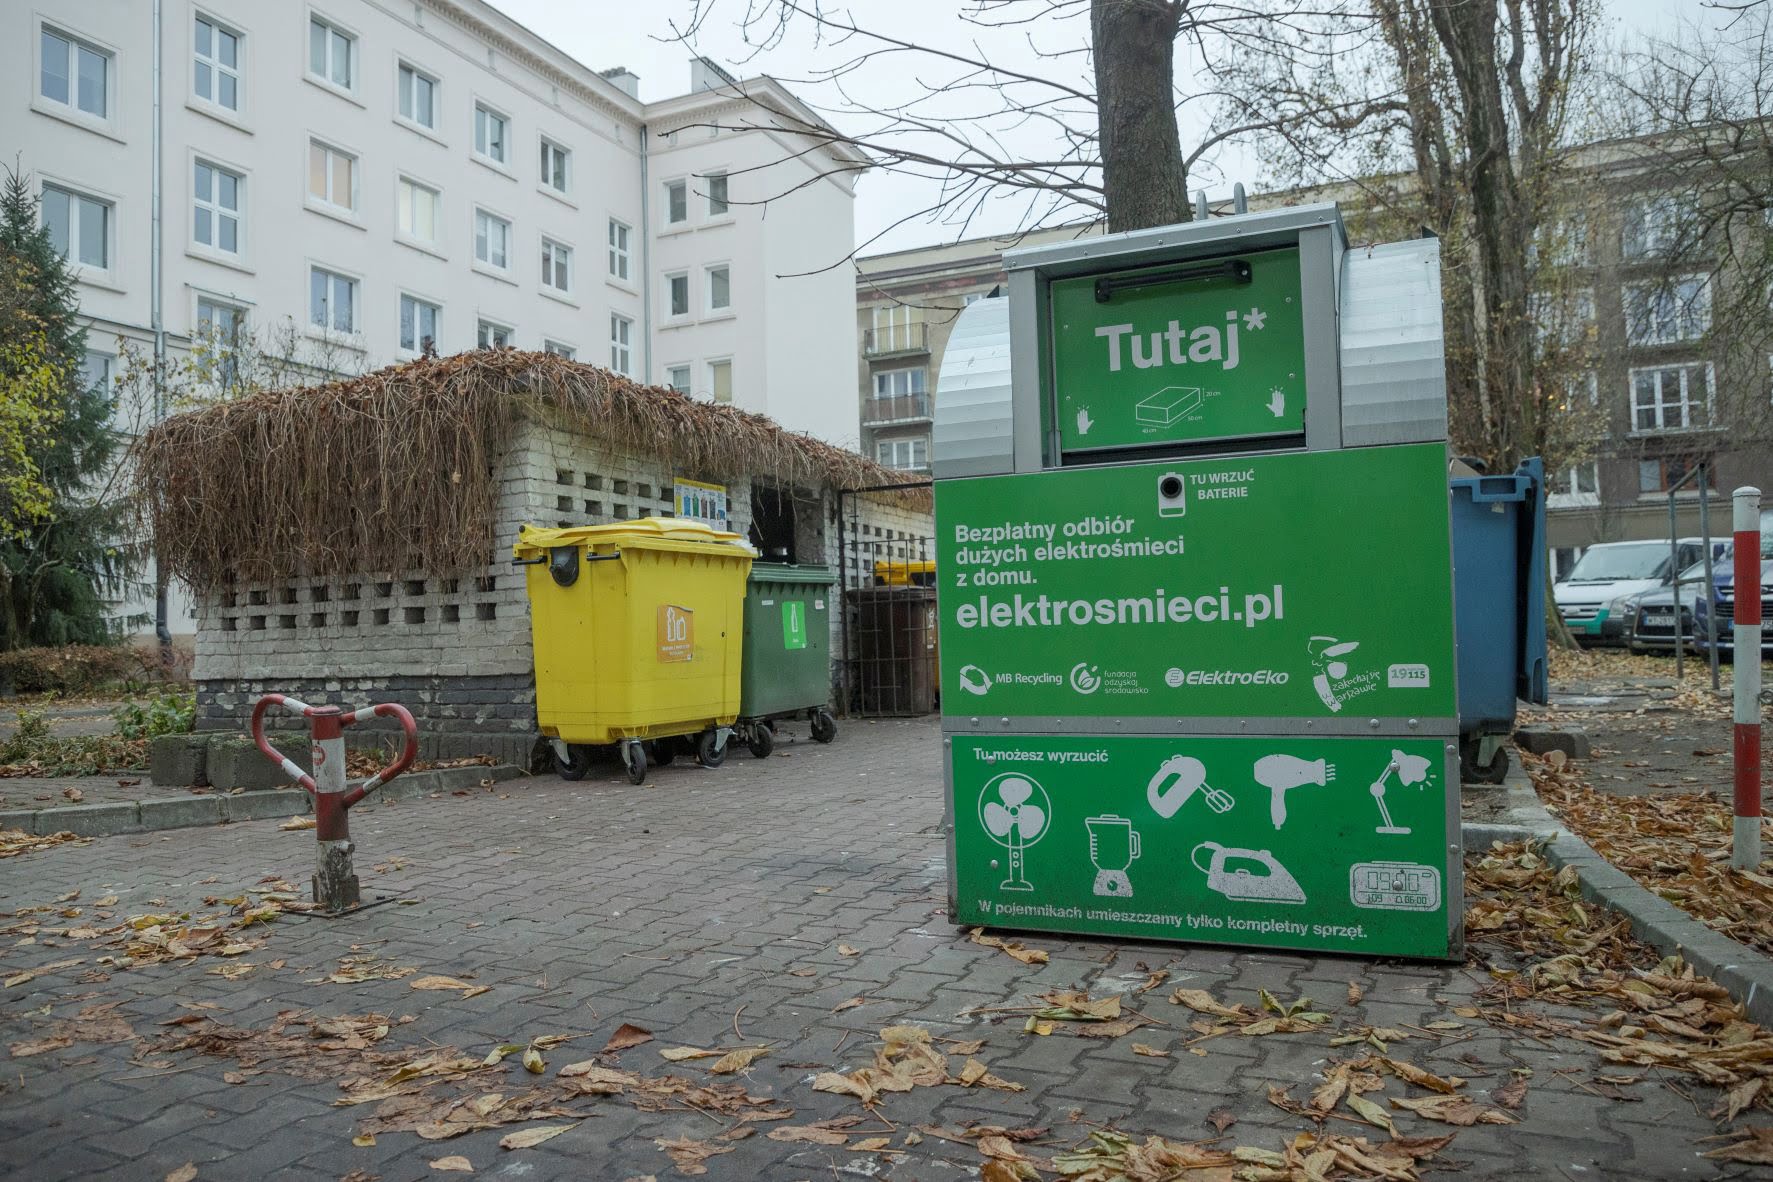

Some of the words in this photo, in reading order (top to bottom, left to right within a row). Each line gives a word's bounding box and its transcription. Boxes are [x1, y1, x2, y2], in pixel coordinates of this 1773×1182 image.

[1190, 474, 1206, 484] TU
[1208, 468, 1254, 483] WRZUĆ
[1198, 487, 1248, 499] BATERIE
[956, 522, 1056, 544] Bezpłatny
[1062, 516, 1134, 536] odbiór
[956, 544, 1027, 567] dużych
[1034, 536, 1184, 560] elektrośmieci
[956, 573, 967, 586] z
[974, 568, 1038, 586] domu.
[956, 584, 1284, 628] elektrosmieci.pl
[996, 673, 1012, 683] MB
[1016, 673, 1062, 686] Recycling
[1186, 670, 1289, 684] ElektroEko
[1332, 671, 1370, 690] zakochaj
[973, 748, 988, 760] Tu
[992, 748, 1044, 761] możesz
[1047, 750, 1108, 764] wyrzucić
[978, 900, 992, 912] W
[995, 903, 1082, 919] pojemnikach
[1087, 908, 1182, 928] umieszczamy
[1186, 914, 1223, 928] tylko
[1228, 916, 1308, 936] kompletny
[1313, 924, 1368, 940] sprzęt.
